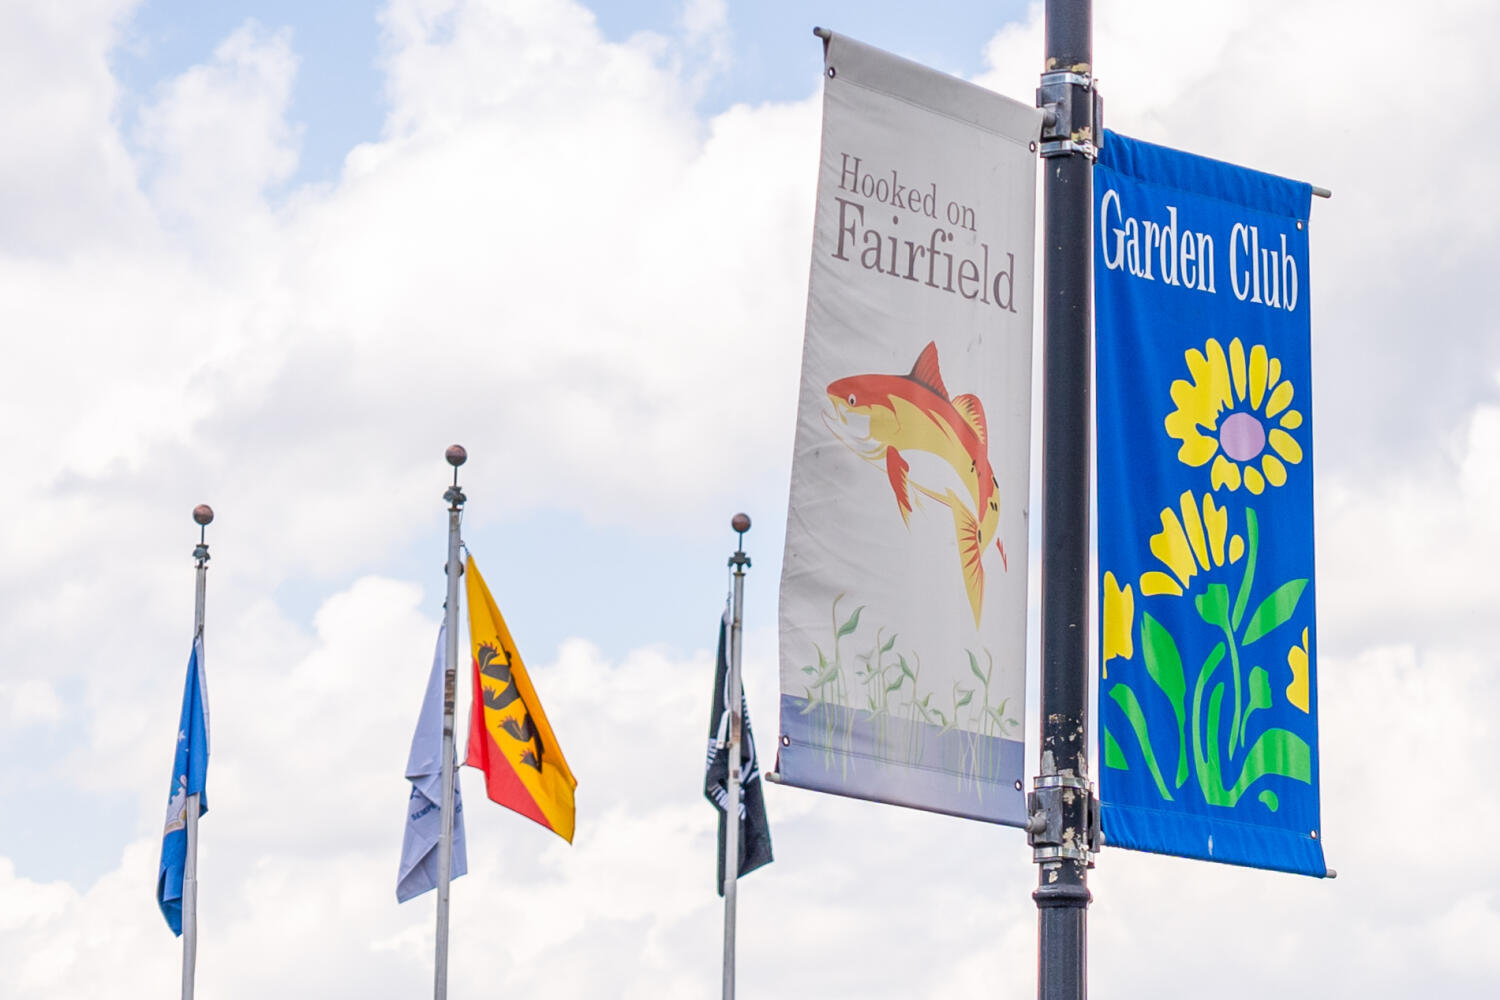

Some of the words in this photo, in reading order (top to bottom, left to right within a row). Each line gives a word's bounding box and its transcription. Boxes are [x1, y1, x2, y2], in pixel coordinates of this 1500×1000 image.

[838, 152, 937, 219] Hooked
[947, 201, 977, 232] on
[1101, 189, 1216, 294] Garden
[1229, 222, 1298, 312] Club
[831, 196, 1017, 313] Fairfield
